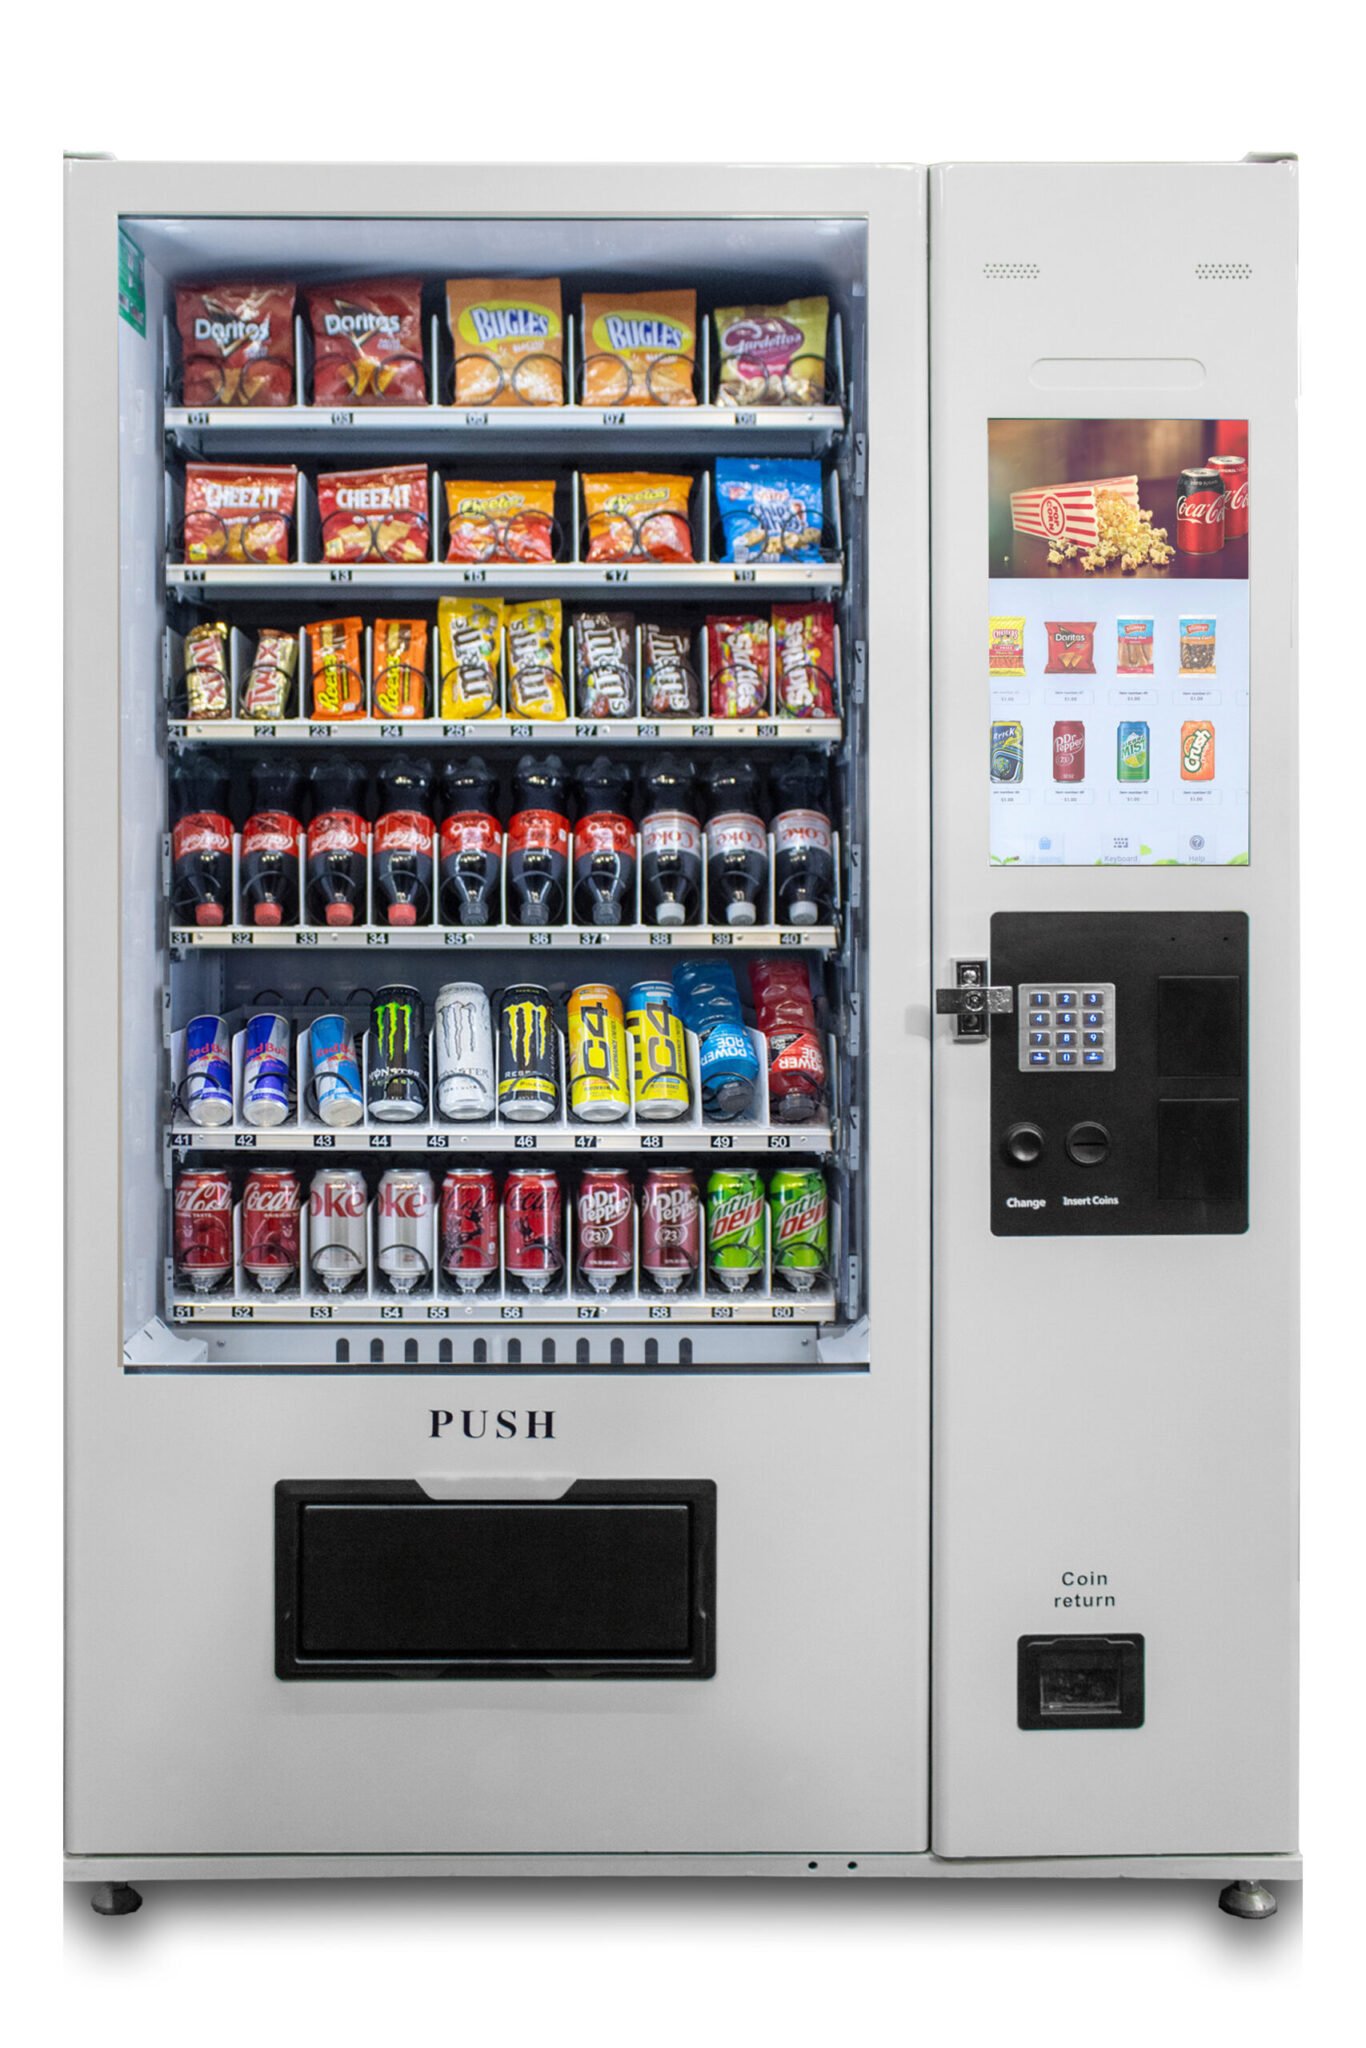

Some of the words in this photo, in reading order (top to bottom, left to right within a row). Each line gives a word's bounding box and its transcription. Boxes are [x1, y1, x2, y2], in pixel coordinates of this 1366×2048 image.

[195, 316, 270, 341] Doritos
[324, 312, 401, 335] Doritos
[470, 307, 549, 343] BUGLES
[605, 316, 682, 350] BUGLES
[335, 484, 411, 509] CHEEZ-IT
[1055, 633, 1086, 642] Doritos
[781, 620, 813, 707] Skittles
[246, 643, 281, 708] TWIX
[168, 726, 185, 737] 21
[255, 726, 275, 737] 22
[310, 726, 330, 737] 23
[382, 726, 400, 737] 24
[446, 725, 464, 737] 25
[512, 725, 531, 737] 26
[577, 725, 595, 737] 27
[639, 725, 658, 737] 28
[694, 725, 713, 737] 29
[758, 725, 777, 737] 30
[1063, 733, 1077, 744] Dr
[1054, 737, 1083, 753] Pepper
[1184, 729, 1212, 772] Crush
[1104, 855, 1138, 864] Keyboard
[1188, 855, 1206, 864] Help
[174, 933, 190, 944] 31
[234, 933, 251, 944] 32
[299, 933, 317, 944] 33
[369, 933, 387, 944] 34
[447, 933, 464, 944] 35
[531, 933, 549, 944] 36
[582, 933, 598, 944] 37
[651, 933, 669, 944] 38
[713, 933, 731, 944] 39
[781, 933, 798, 944] 40
[1037, 994, 1042, 1003] 1
[1063, 994, 1070, 1003] 2
[1090, 994, 1097, 1003] 3
[1036, 1014, 1042, 1022] 4
[1064, 1014, 1071, 1022] 5
[1089, 1014, 1097, 1022] 6
[580, 1001, 611, 1078] C4
[646, 999, 677, 1074] C4
[1036, 1033, 1042, 1043] 7
[1063, 1033, 1070, 1042] 8
[1090, 1033, 1097, 1042] 9
[701, 1047, 747, 1066] POWER
[1063, 1053, 1070, 1062] 0
[174, 1135, 190, 1146] 41
[236, 1135, 254, 1146] 42
[315, 1135, 333, 1146] 43
[371, 1135, 389, 1147] 44
[428, 1136, 446, 1147] 45
[516, 1136, 534, 1147] 46
[576, 1136, 594, 1147] 47
[642, 1136, 660, 1147] 48
[713, 1137, 731, 1148] 49
[770, 1137, 788, 1148] 50
[594, 1190, 620, 1206] Dr
[671, 1189, 692, 1205] Dr
[1062, 1196, 1091, 1206] Insert
[1092, 1195, 1119, 1206] Coins
[579, 1194, 630, 1224] Pepper
[655, 1194, 699, 1224] Pepper
[1006, 1197, 1046, 1210] Change
[664, 1230, 678, 1241] 23
[175, 1307, 193, 1317] 51
[233, 1307, 251, 1317] 52
[312, 1307, 330, 1318] 53
[383, 1307, 400, 1318] 54
[429, 1307, 446, 1318] 55
[503, 1307, 520, 1318] 56
[580, 1307, 597, 1318] 57
[651, 1307, 669, 1318] 58
[714, 1307, 730, 1318] 59
[774, 1307, 791, 1318] 60
[428, 1409, 556, 1439] PUSH
[1061, 1571, 1109, 1586] Coin
[1053, 1594, 1116, 1608] return
